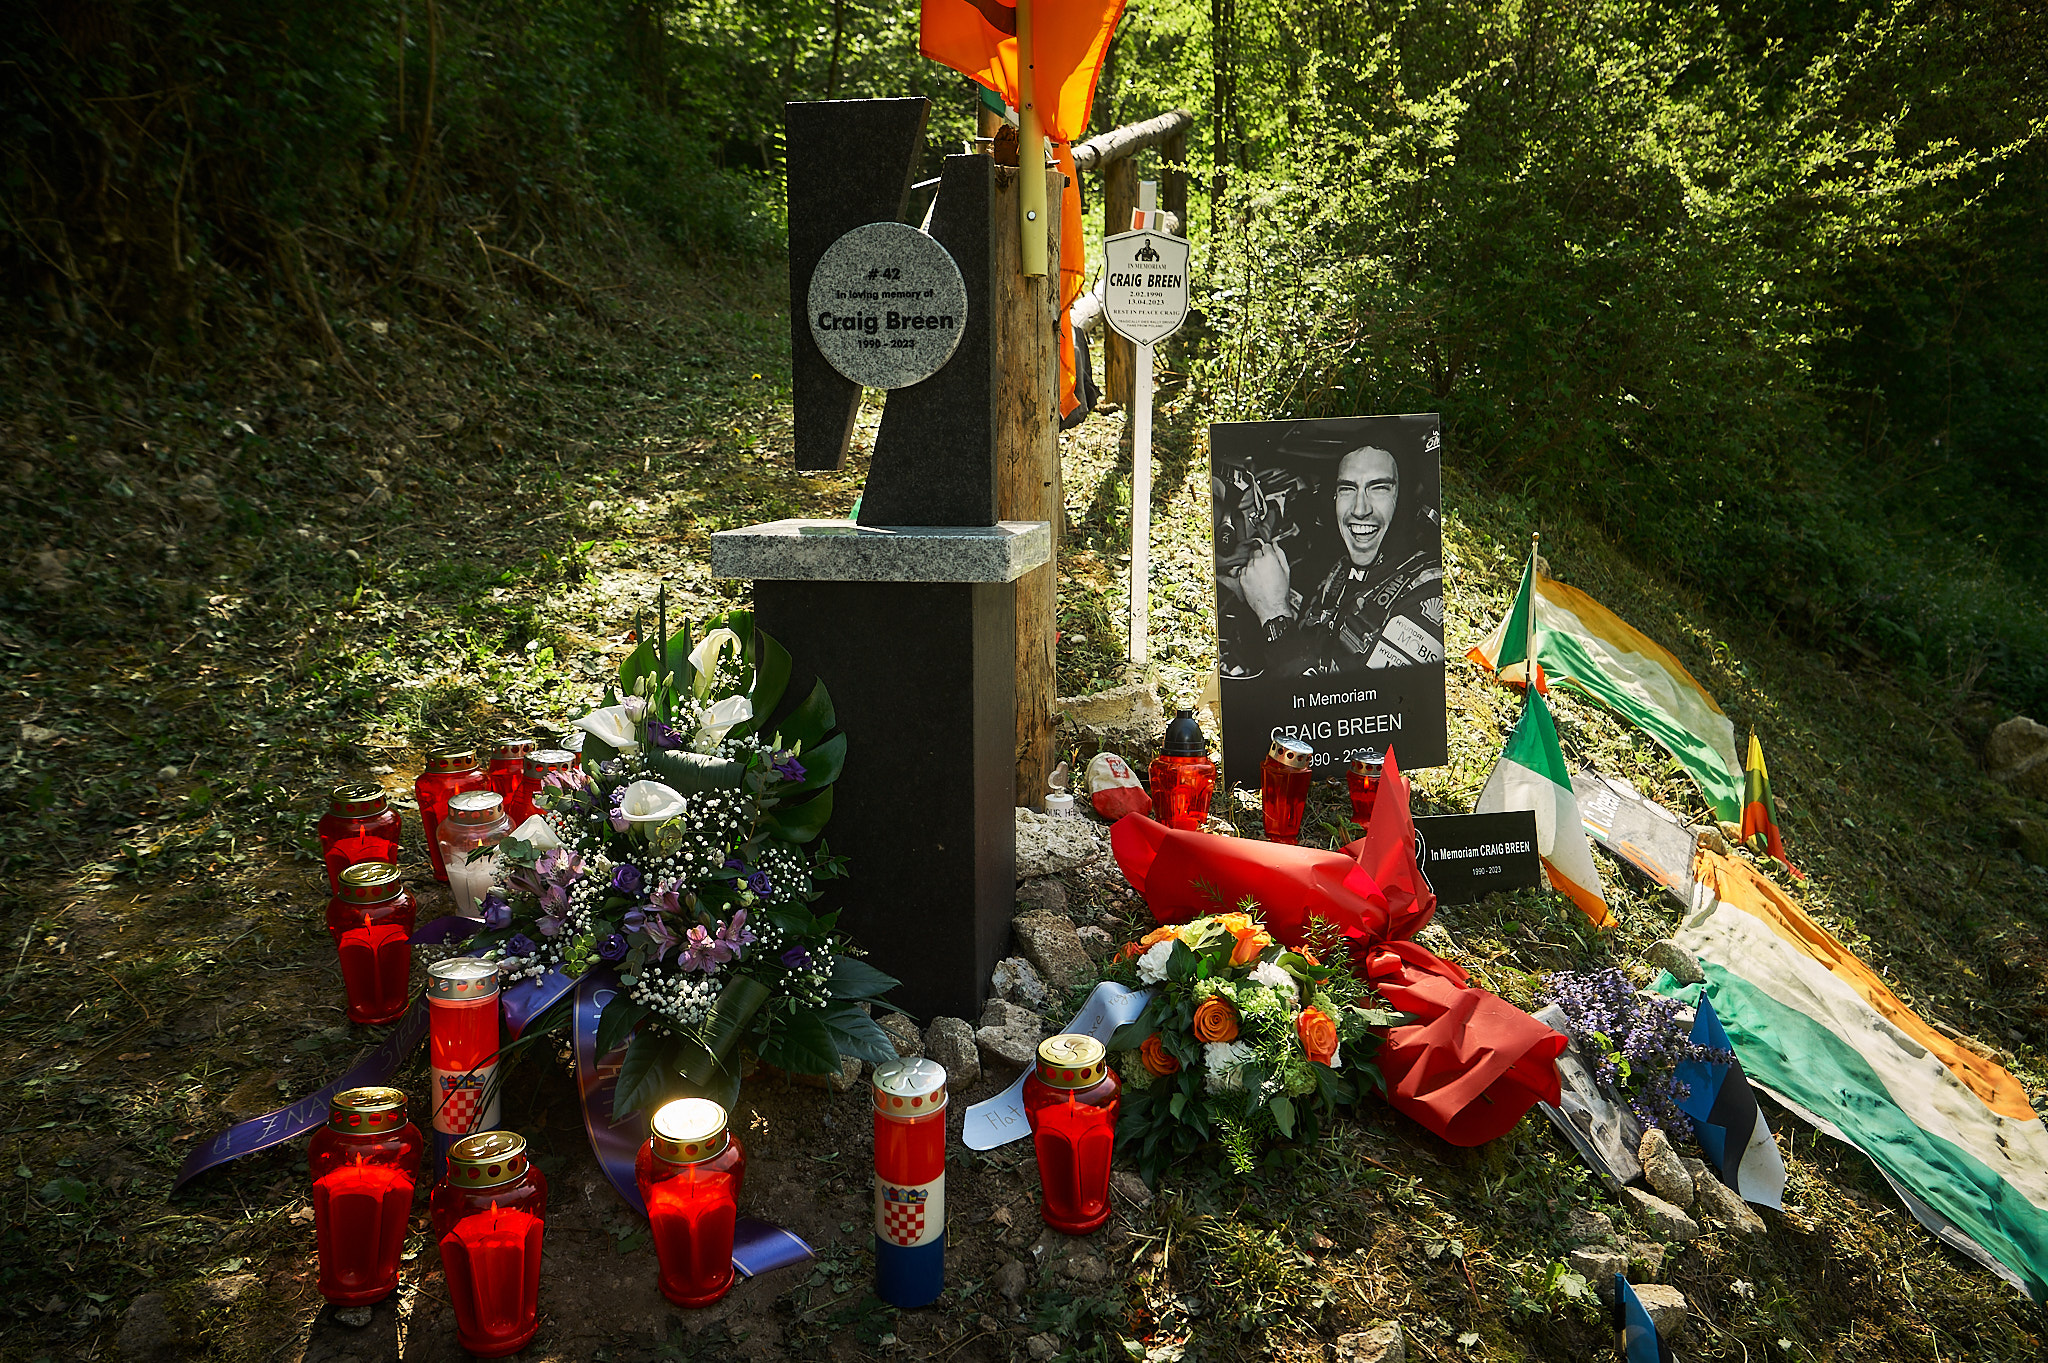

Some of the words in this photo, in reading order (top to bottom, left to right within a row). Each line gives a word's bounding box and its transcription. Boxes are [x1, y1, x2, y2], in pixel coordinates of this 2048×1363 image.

[882, 268, 900, 280] 42
[1110, 273, 1142, 287] CRAIG
[1147, 274, 1182, 288] BREEN
[836, 290, 846, 299] In
[849, 289, 878, 300] loving
[881, 289, 921, 300] memory
[923, 288, 934, 298] of
[818, 310, 878, 335] Craig
[886, 311, 953, 330] Breen
[858, 340, 881, 349] 1990
[890, 340, 915, 349] 2023
[1377, 574, 1404, 606] OMP
[1396, 619, 1425, 642] HYUNDAI
[1397, 630, 1438, 664] MOBIS
[1293, 694, 1305, 709] In
[1309, 688, 1377, 707] Memoriam
[1270, 721, 1332, 742] CRAIG
[1337, 713, 1402, 737] BREEN
[1308, 752, 1330, 768] 990
[1430, 849, 1439, 861] In
[1440, 846, 1479, 861] Memoriam
[1480, 843, 1504, 857] CRAIG
[1504, 841, 1530, 854] BREEN
[1472, 867, 1485, 876] 1990
[1488, 866, 1501, 874] 2023
[982, 1104, 1022, 1130] Flat
